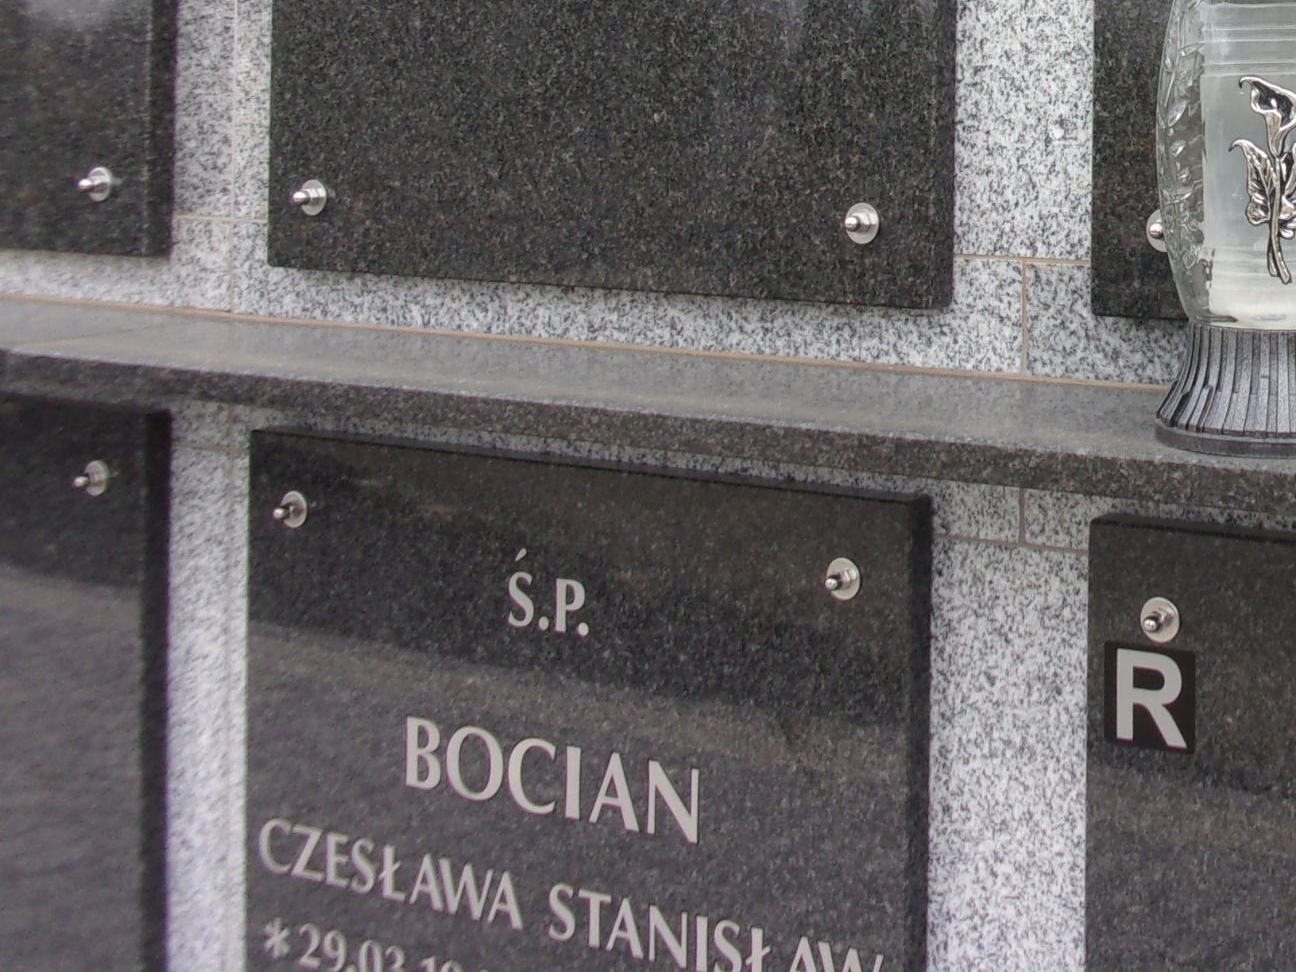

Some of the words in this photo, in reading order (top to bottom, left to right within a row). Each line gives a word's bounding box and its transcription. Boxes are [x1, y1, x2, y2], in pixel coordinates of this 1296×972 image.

[507, 547, 591, 637] Ś.P.
[1115, 647, 1187, 749] R
[405, 715, 701, 844] BOCIAN
[259, 818, 523, 929] CZESŁAWA
